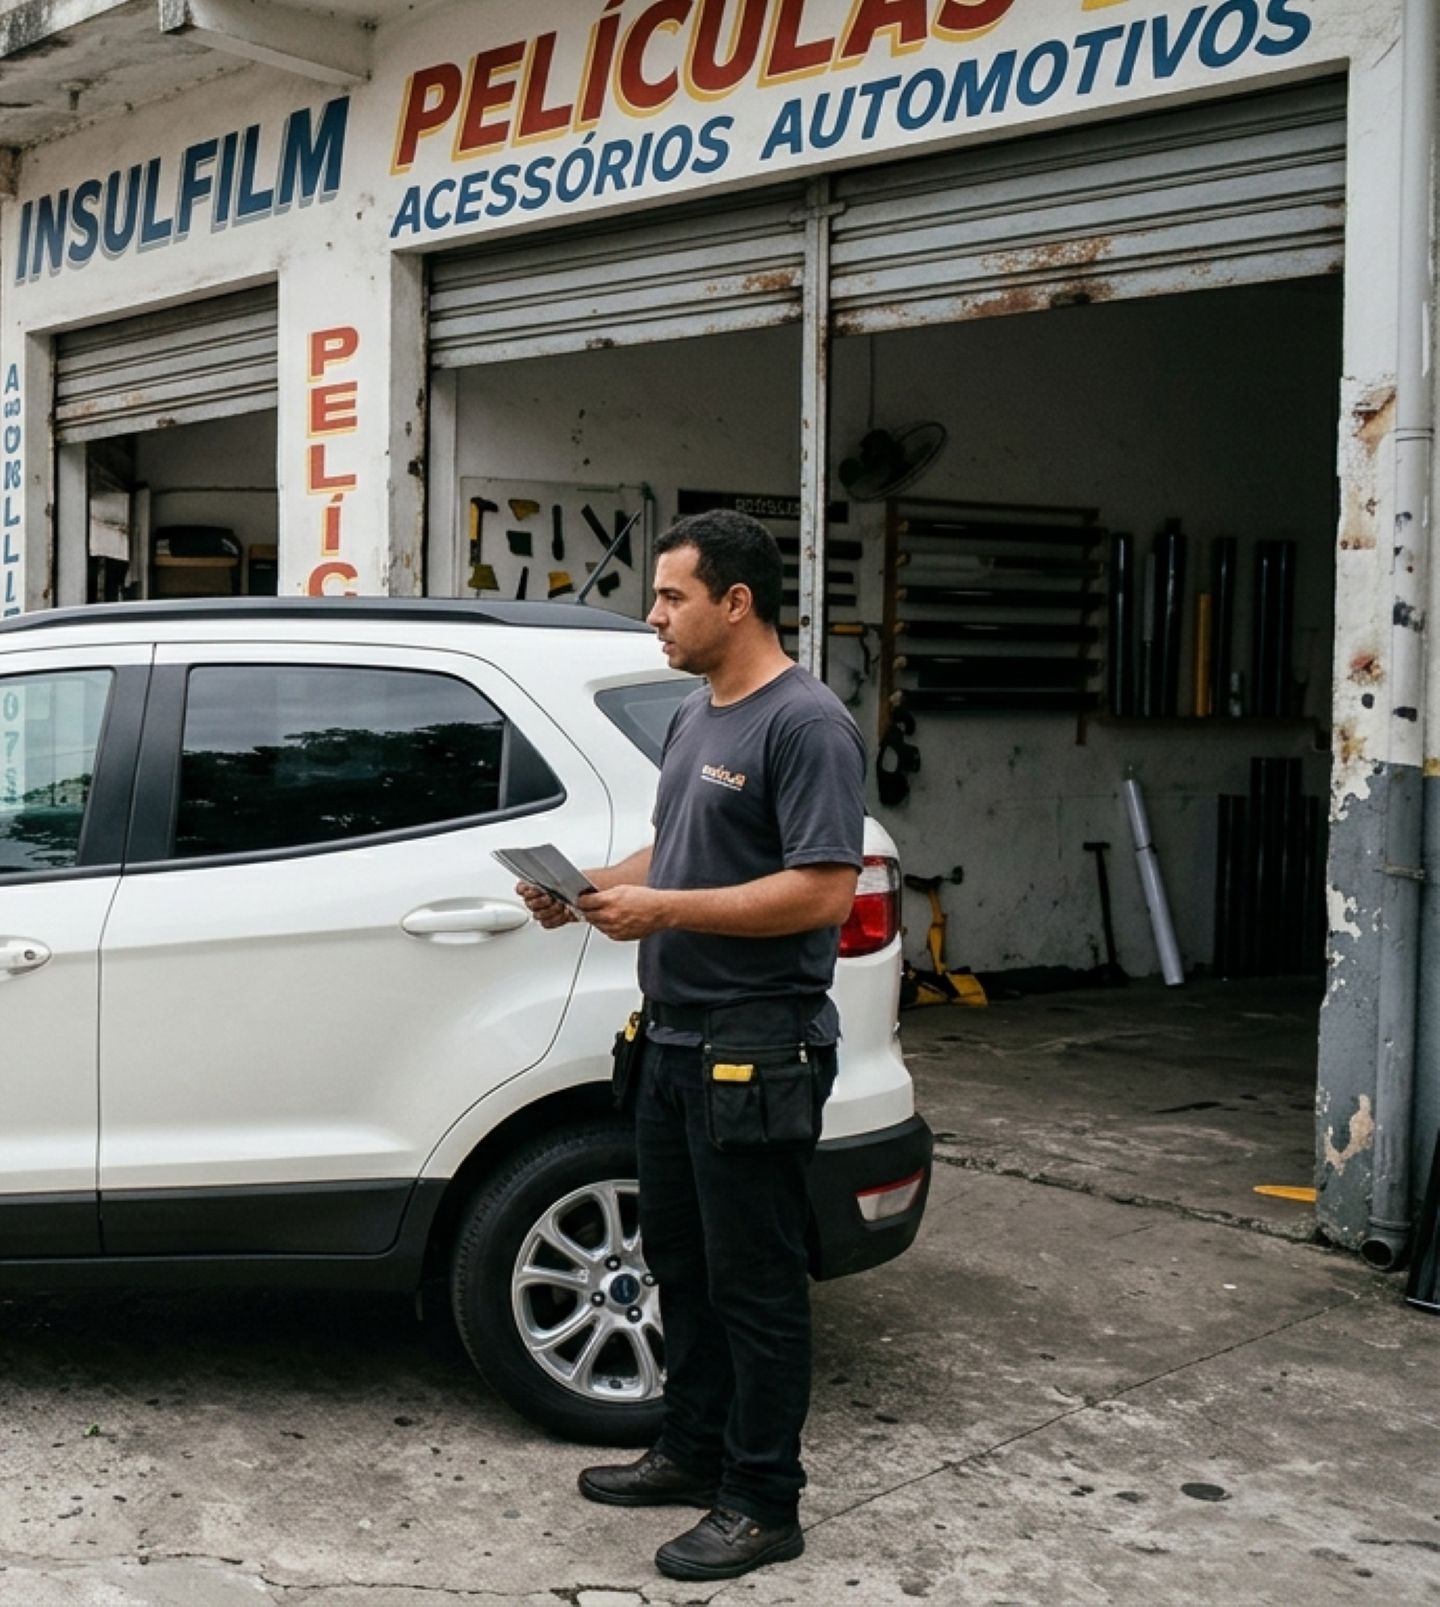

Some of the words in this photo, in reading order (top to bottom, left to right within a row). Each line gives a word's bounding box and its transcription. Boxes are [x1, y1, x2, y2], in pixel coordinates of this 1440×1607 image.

[390, 0, 1016, 175] PELÍCULA
[390, 115, 734, 238] ACESSÓRIOS
[760, 0, 1313, 160] AUTOMOTIVOS
[14, 95, 350, 284] INSULFILM
